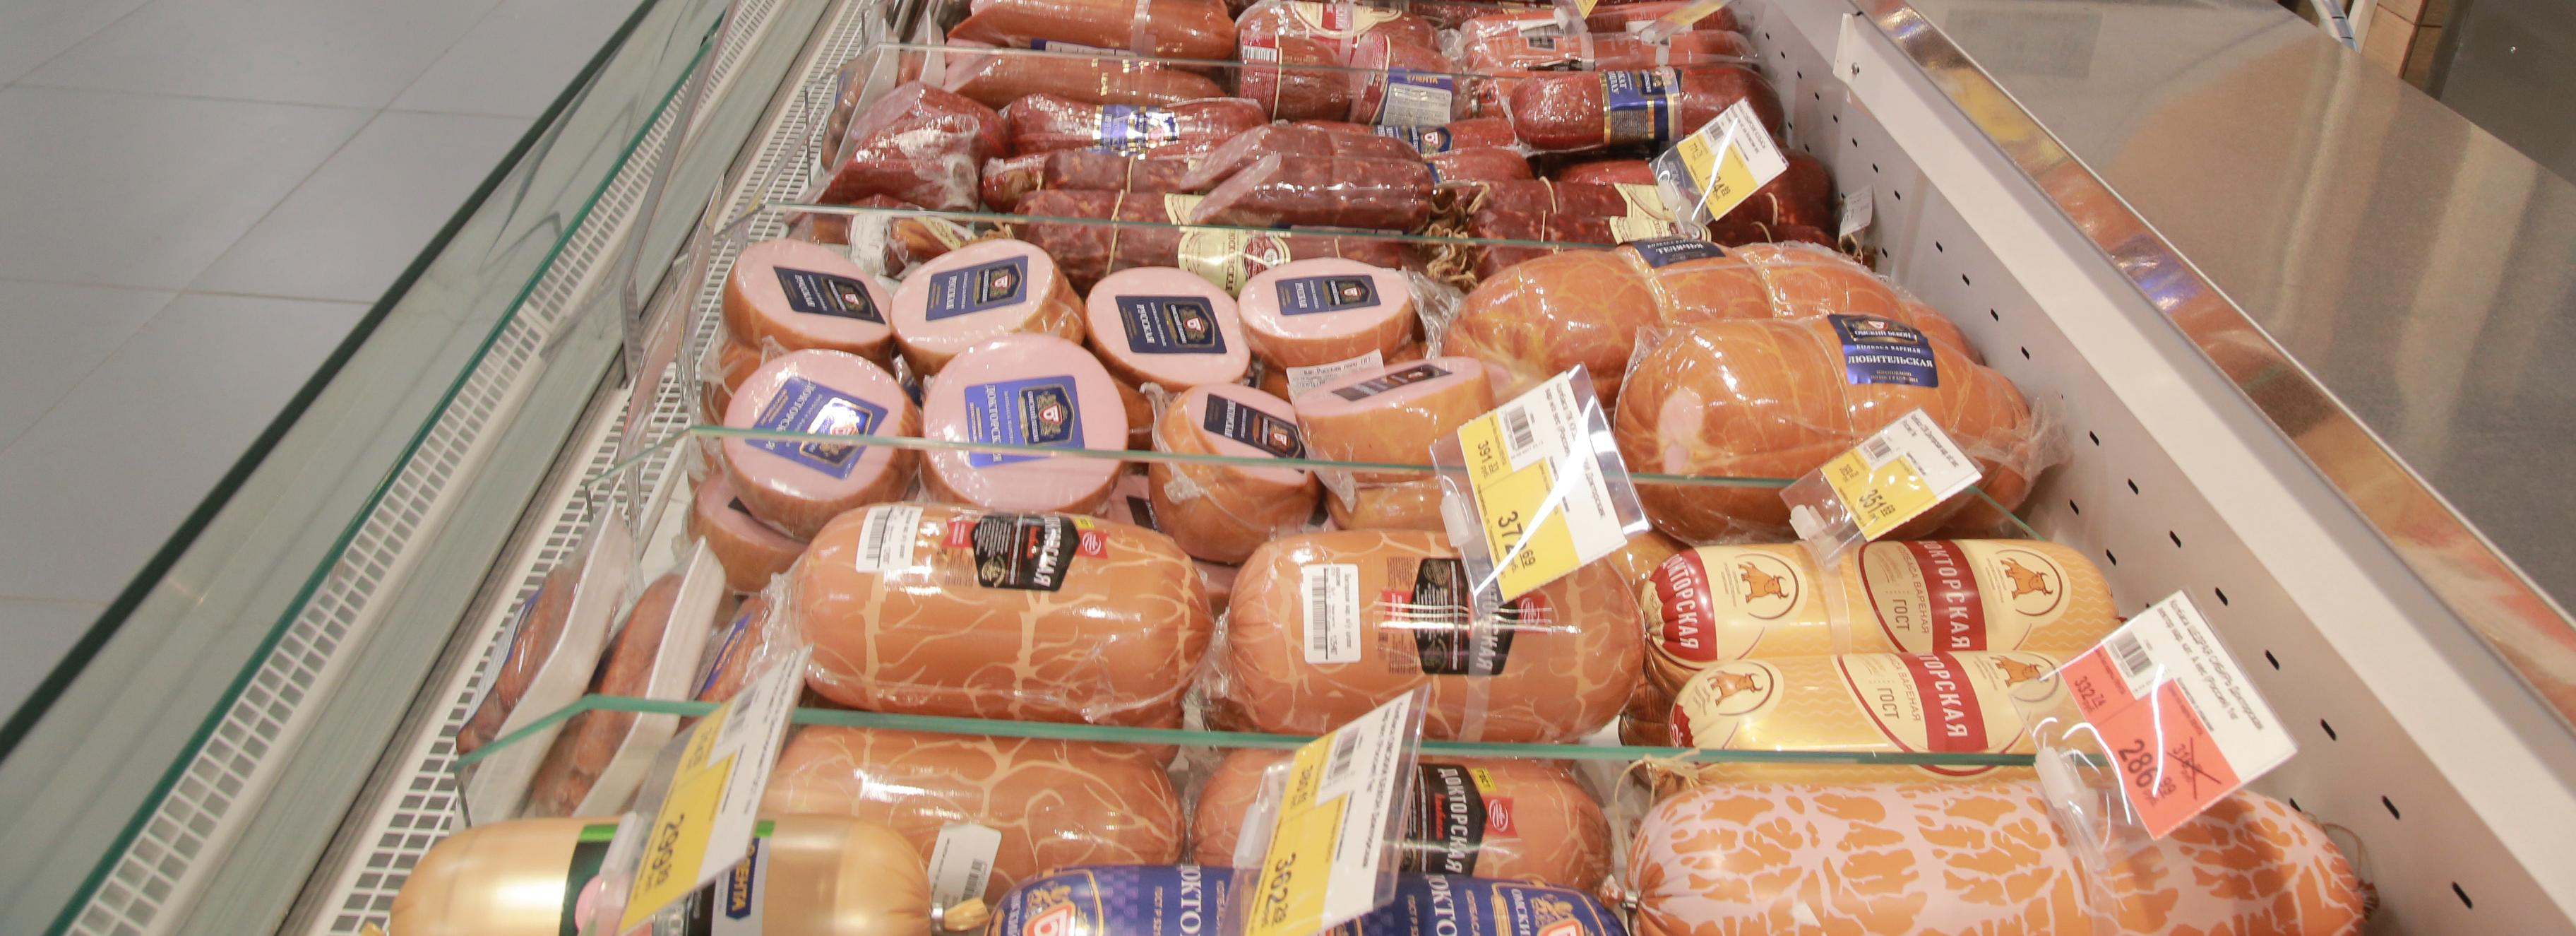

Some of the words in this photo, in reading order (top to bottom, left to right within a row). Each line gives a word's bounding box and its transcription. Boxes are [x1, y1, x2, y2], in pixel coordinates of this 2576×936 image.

[1848, 355, 1933, 368] ЛЮБИТЕЛЬСКАЯ
[764, 381, 817, 451] ДОКТОРСКЯ
[985, 384, 1002, 462] ДОКТОРСКЯ
[1477, 439, 1493, 463] 391
[1857, 487, 1887, 515] 351
[1521, 547, 1536, 568] 69
[1475, 574, 1498, 671] КТОРСКАЯ
[1663, 553, 1700, 651] ДОКТОРСКАЯ
[1892, 597, 1911, 632] ГОСТ
[1913, 581, 1930, 634] ВАРЕНАЯ
[2073, 674, 2097, 701] 332
[2167, 598, 2191, 627] Колбаса
[2186, 624, 2213, 658] ЩЕДРАЯ
[2207, 653, 2235, 687] СИБИРЬ
[2227, 684, 2266, 732] Докторская
[1877, 686, 1900, 721] ГОСТ
[1897, 670, 1921, 722] ВАРЕНАЯ
[2116, 736, 2164, 790] 286
[1438, 767, 1470, 874] ДОКТОРСКАЯ
[1264, 849, 1298, 910] 362
